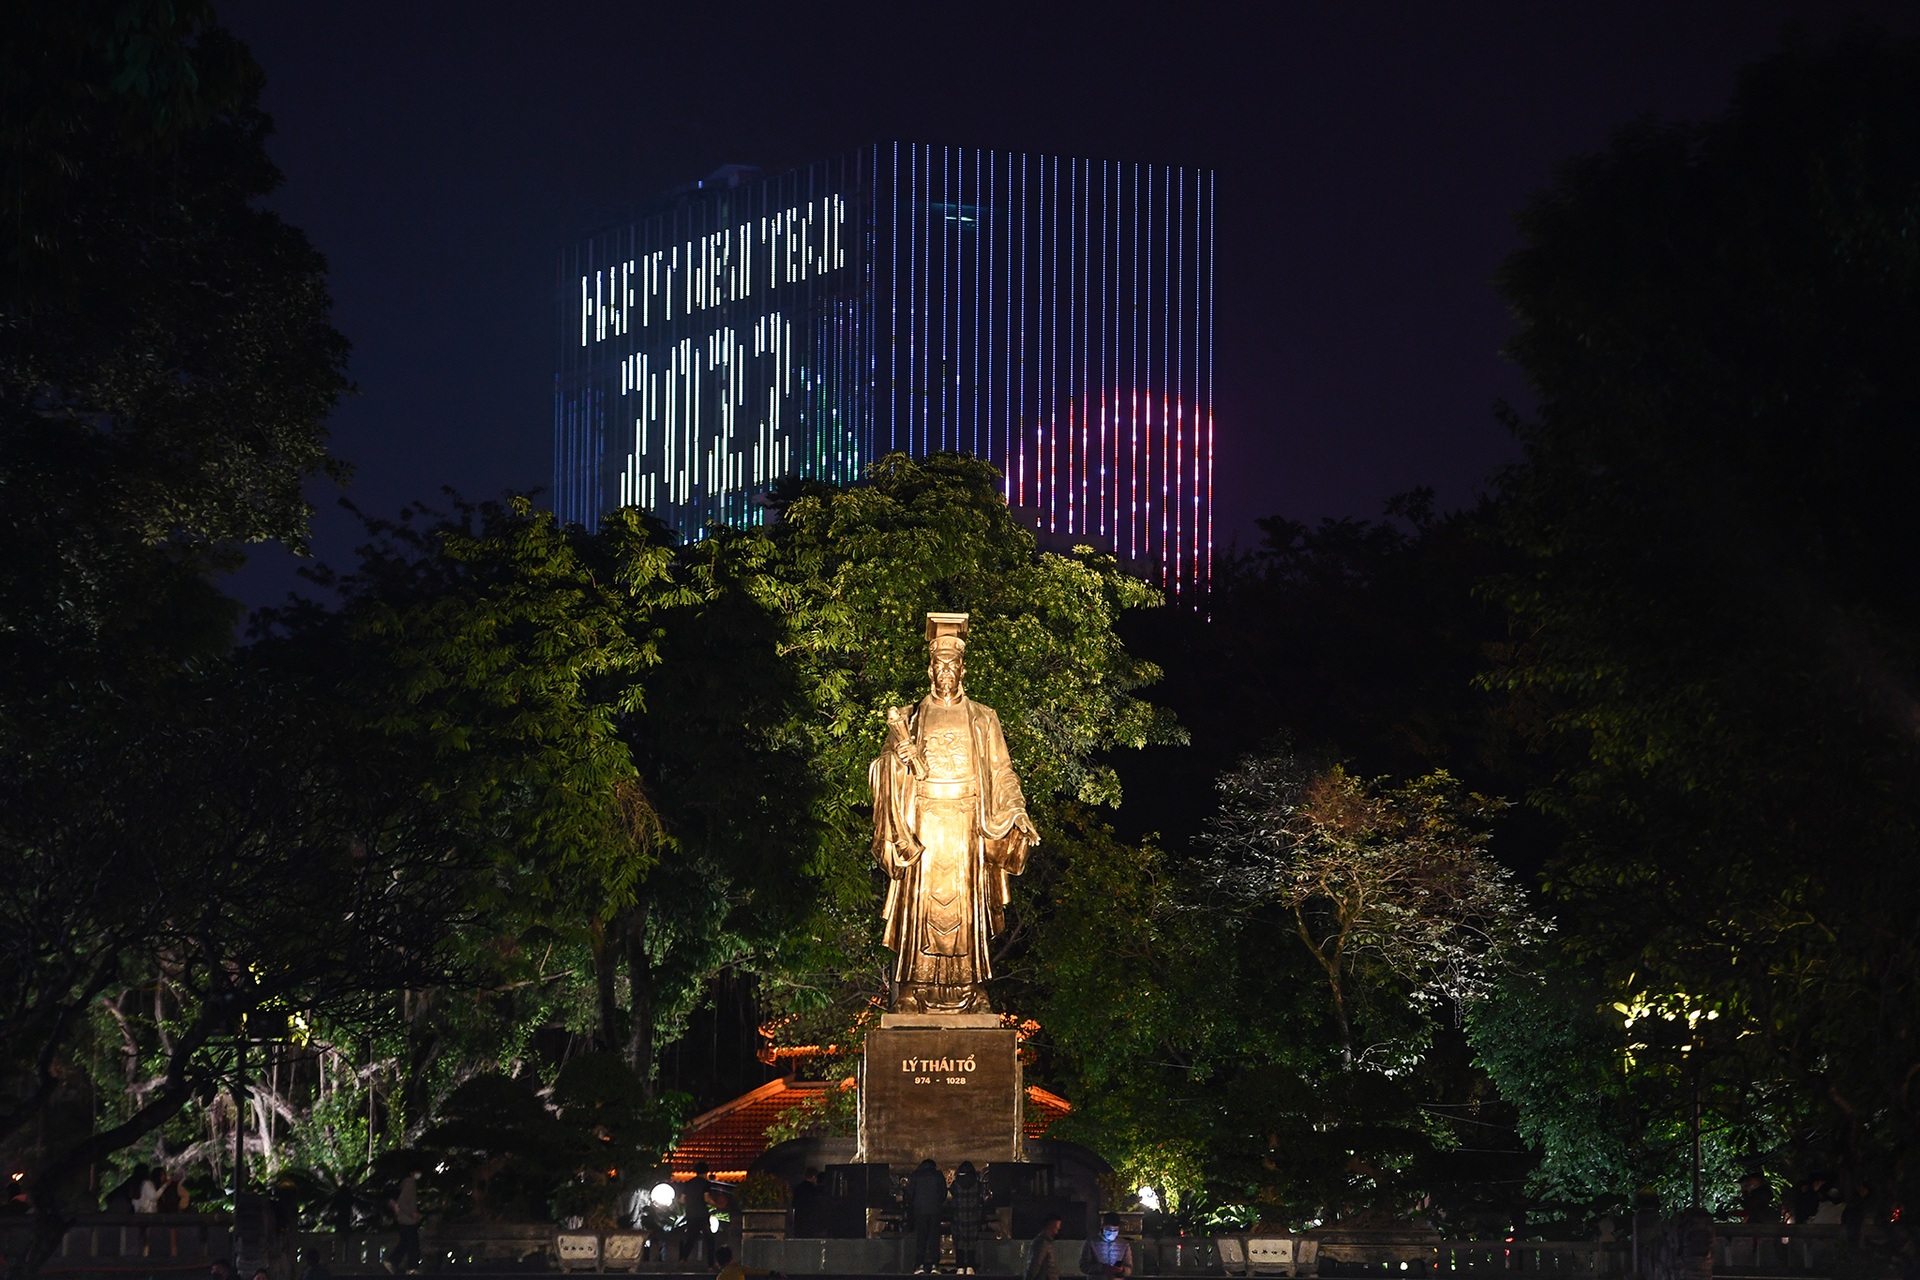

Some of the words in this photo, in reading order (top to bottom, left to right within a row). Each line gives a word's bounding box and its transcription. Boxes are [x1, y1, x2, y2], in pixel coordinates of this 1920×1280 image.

[620, 311, 792, 511] 2022
[902, 1056, 918, 1072] LÝ
[920, 1056, 954, 1072] THÁI
[914, 1076, 931, 1085] 974
[946, 1076, 966, 1085] 1028
